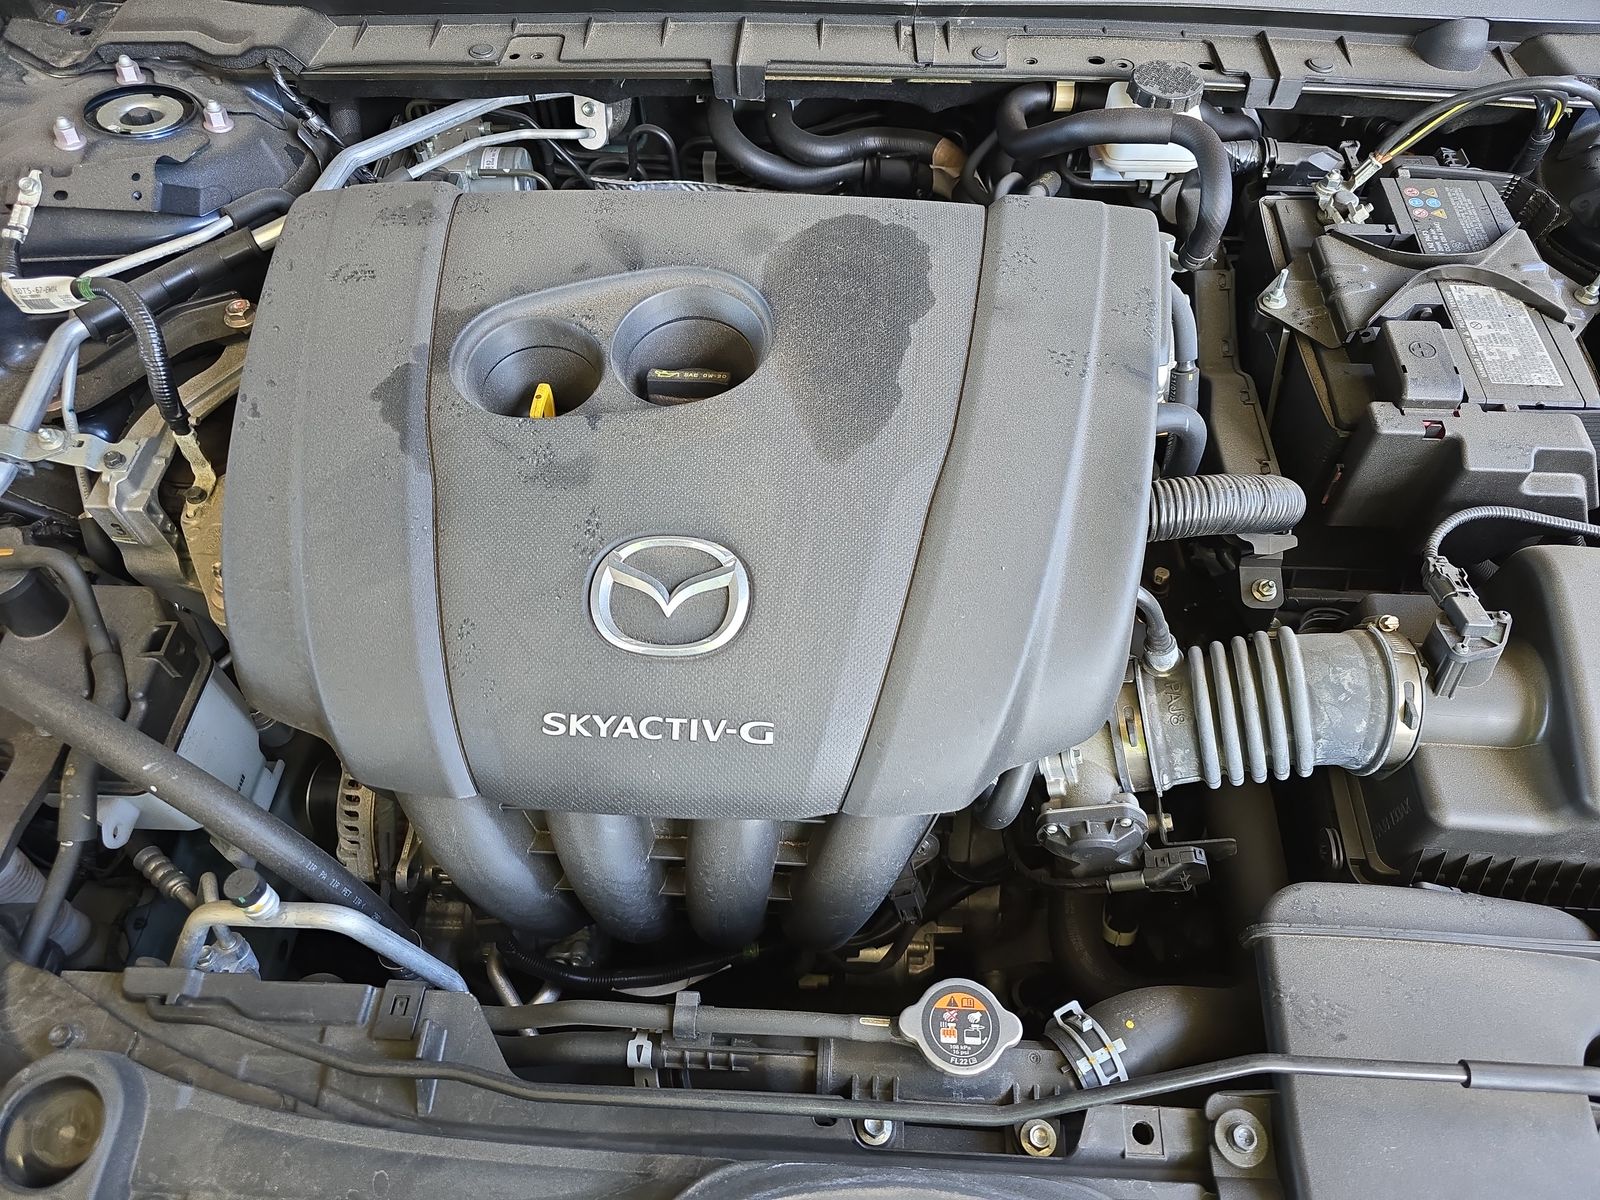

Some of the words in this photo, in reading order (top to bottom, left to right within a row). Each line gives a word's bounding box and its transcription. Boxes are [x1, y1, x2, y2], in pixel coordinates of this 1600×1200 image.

[1164, 681, 1185, 726] PAJ8
[541, 712, 775, 745] SKYACTIV-G
[950, 1056, 969, 1065] FL22
